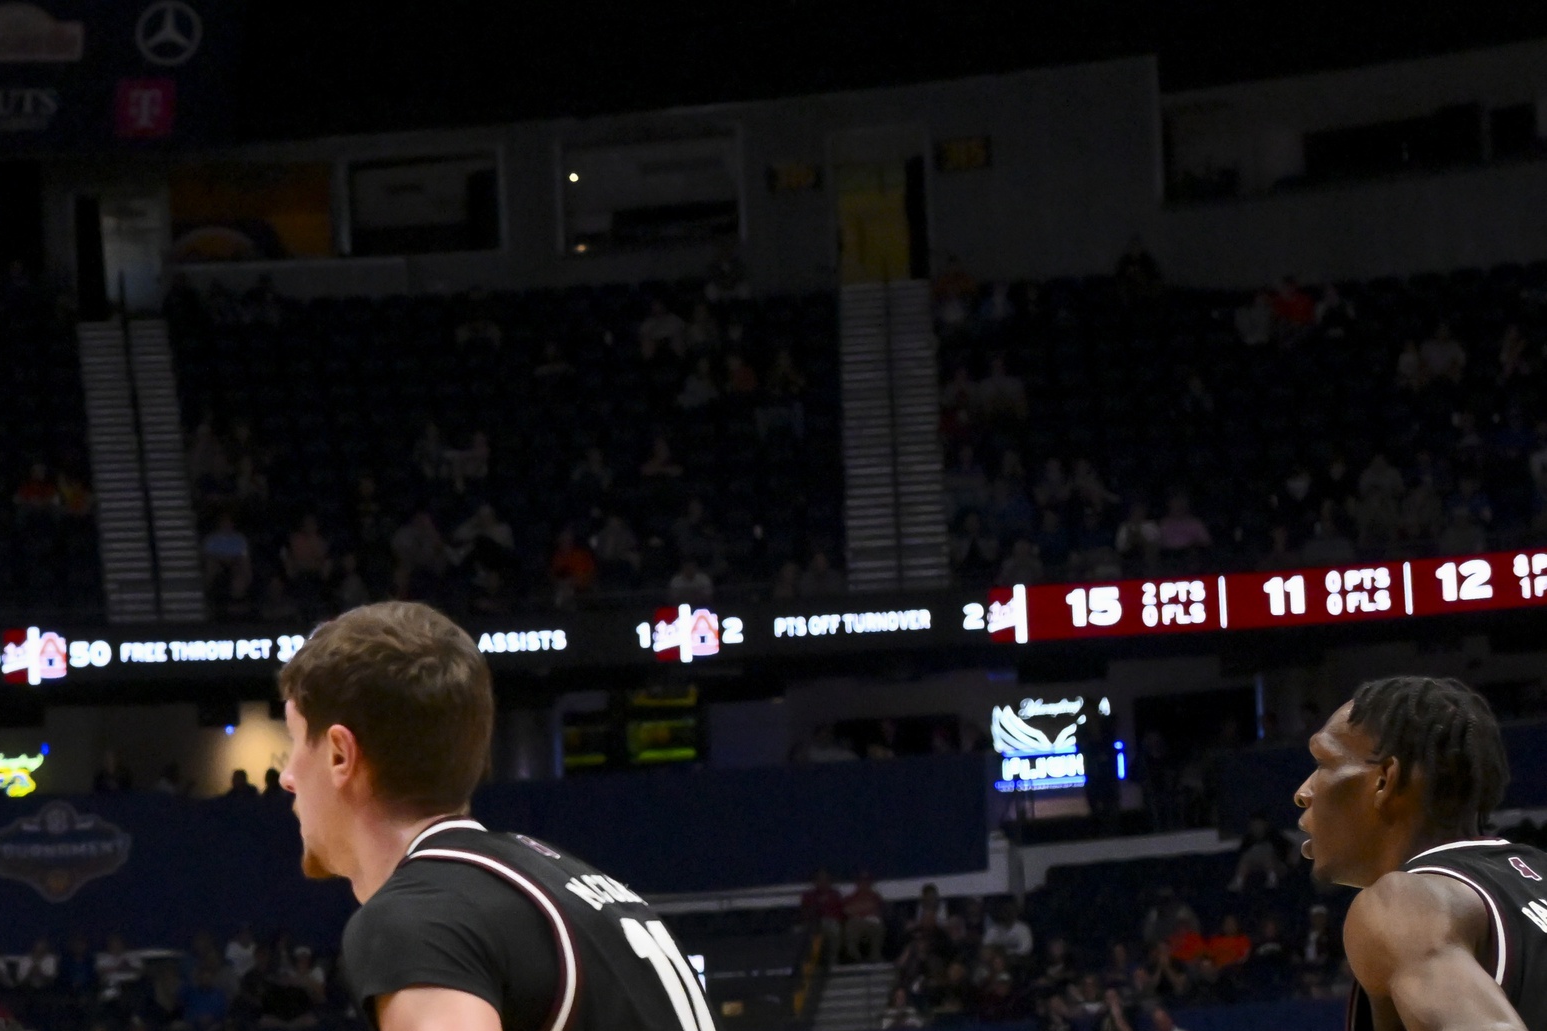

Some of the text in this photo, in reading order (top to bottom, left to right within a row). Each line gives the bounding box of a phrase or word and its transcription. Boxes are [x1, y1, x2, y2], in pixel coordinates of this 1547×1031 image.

[1142, 580, 1206, 605] 2 PTS
[1344, 567, 1391, 592] PTS
[1435, 559, 1493, 602] 12
[1065, 586, 1123, 627] 15
[1263, 575, 1306, 615] 11
[1346, 590, 1392, 613] FLS
[774, 609, 931, 638] PTS OFF TURNOVER
[962, 602, 985, 630] 2
[1162, 602, 1206, 626] FLS
[478, 629, 567, 653] ASSISTS
[637, 622, 651, 649] 1
[722, 617, 744, 643] 2
[69, 640, 111, 668] 50
[119, 642, 168, 662] FREE
[169, 641, 234, 662] THROW
[236, 639, 273, 660] PCT
